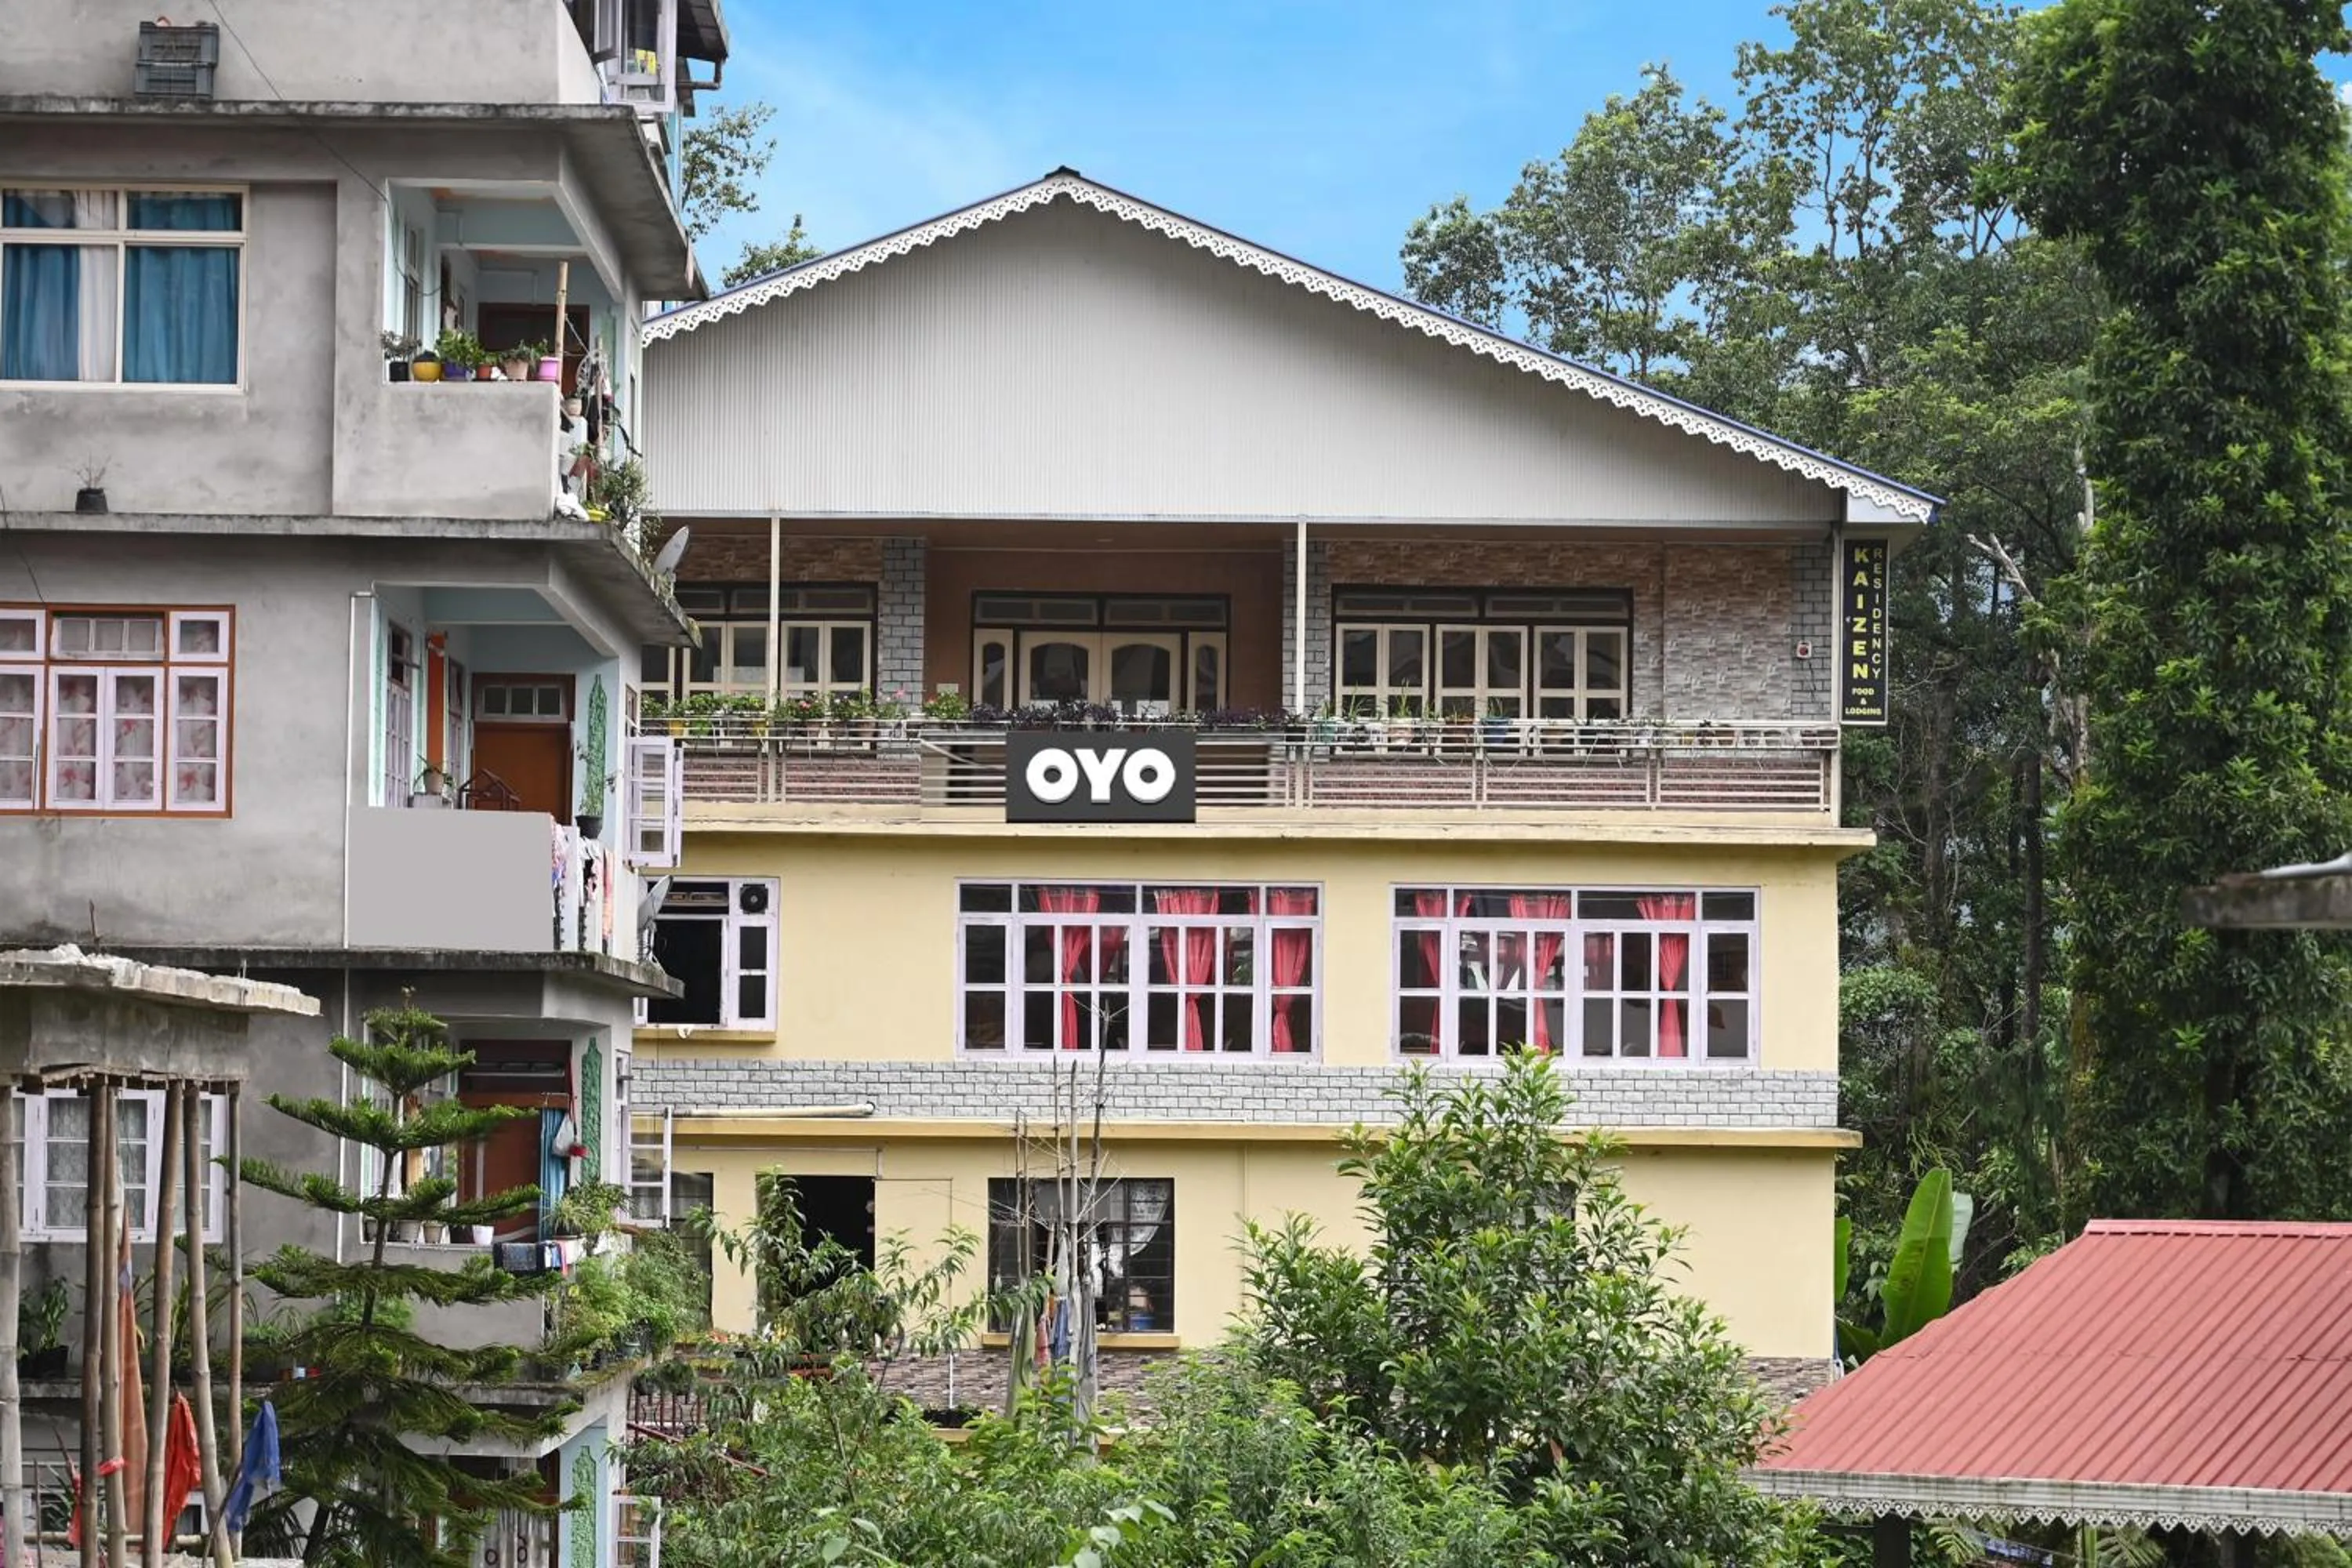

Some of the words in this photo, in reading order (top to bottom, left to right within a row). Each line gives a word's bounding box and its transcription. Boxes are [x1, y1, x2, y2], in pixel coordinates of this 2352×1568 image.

[1853, 547, 1869, 679] KAIZEN
[1872, 548, 1882, 680] RESIDENCY
[1025, 748, 1176, 804] OYO
